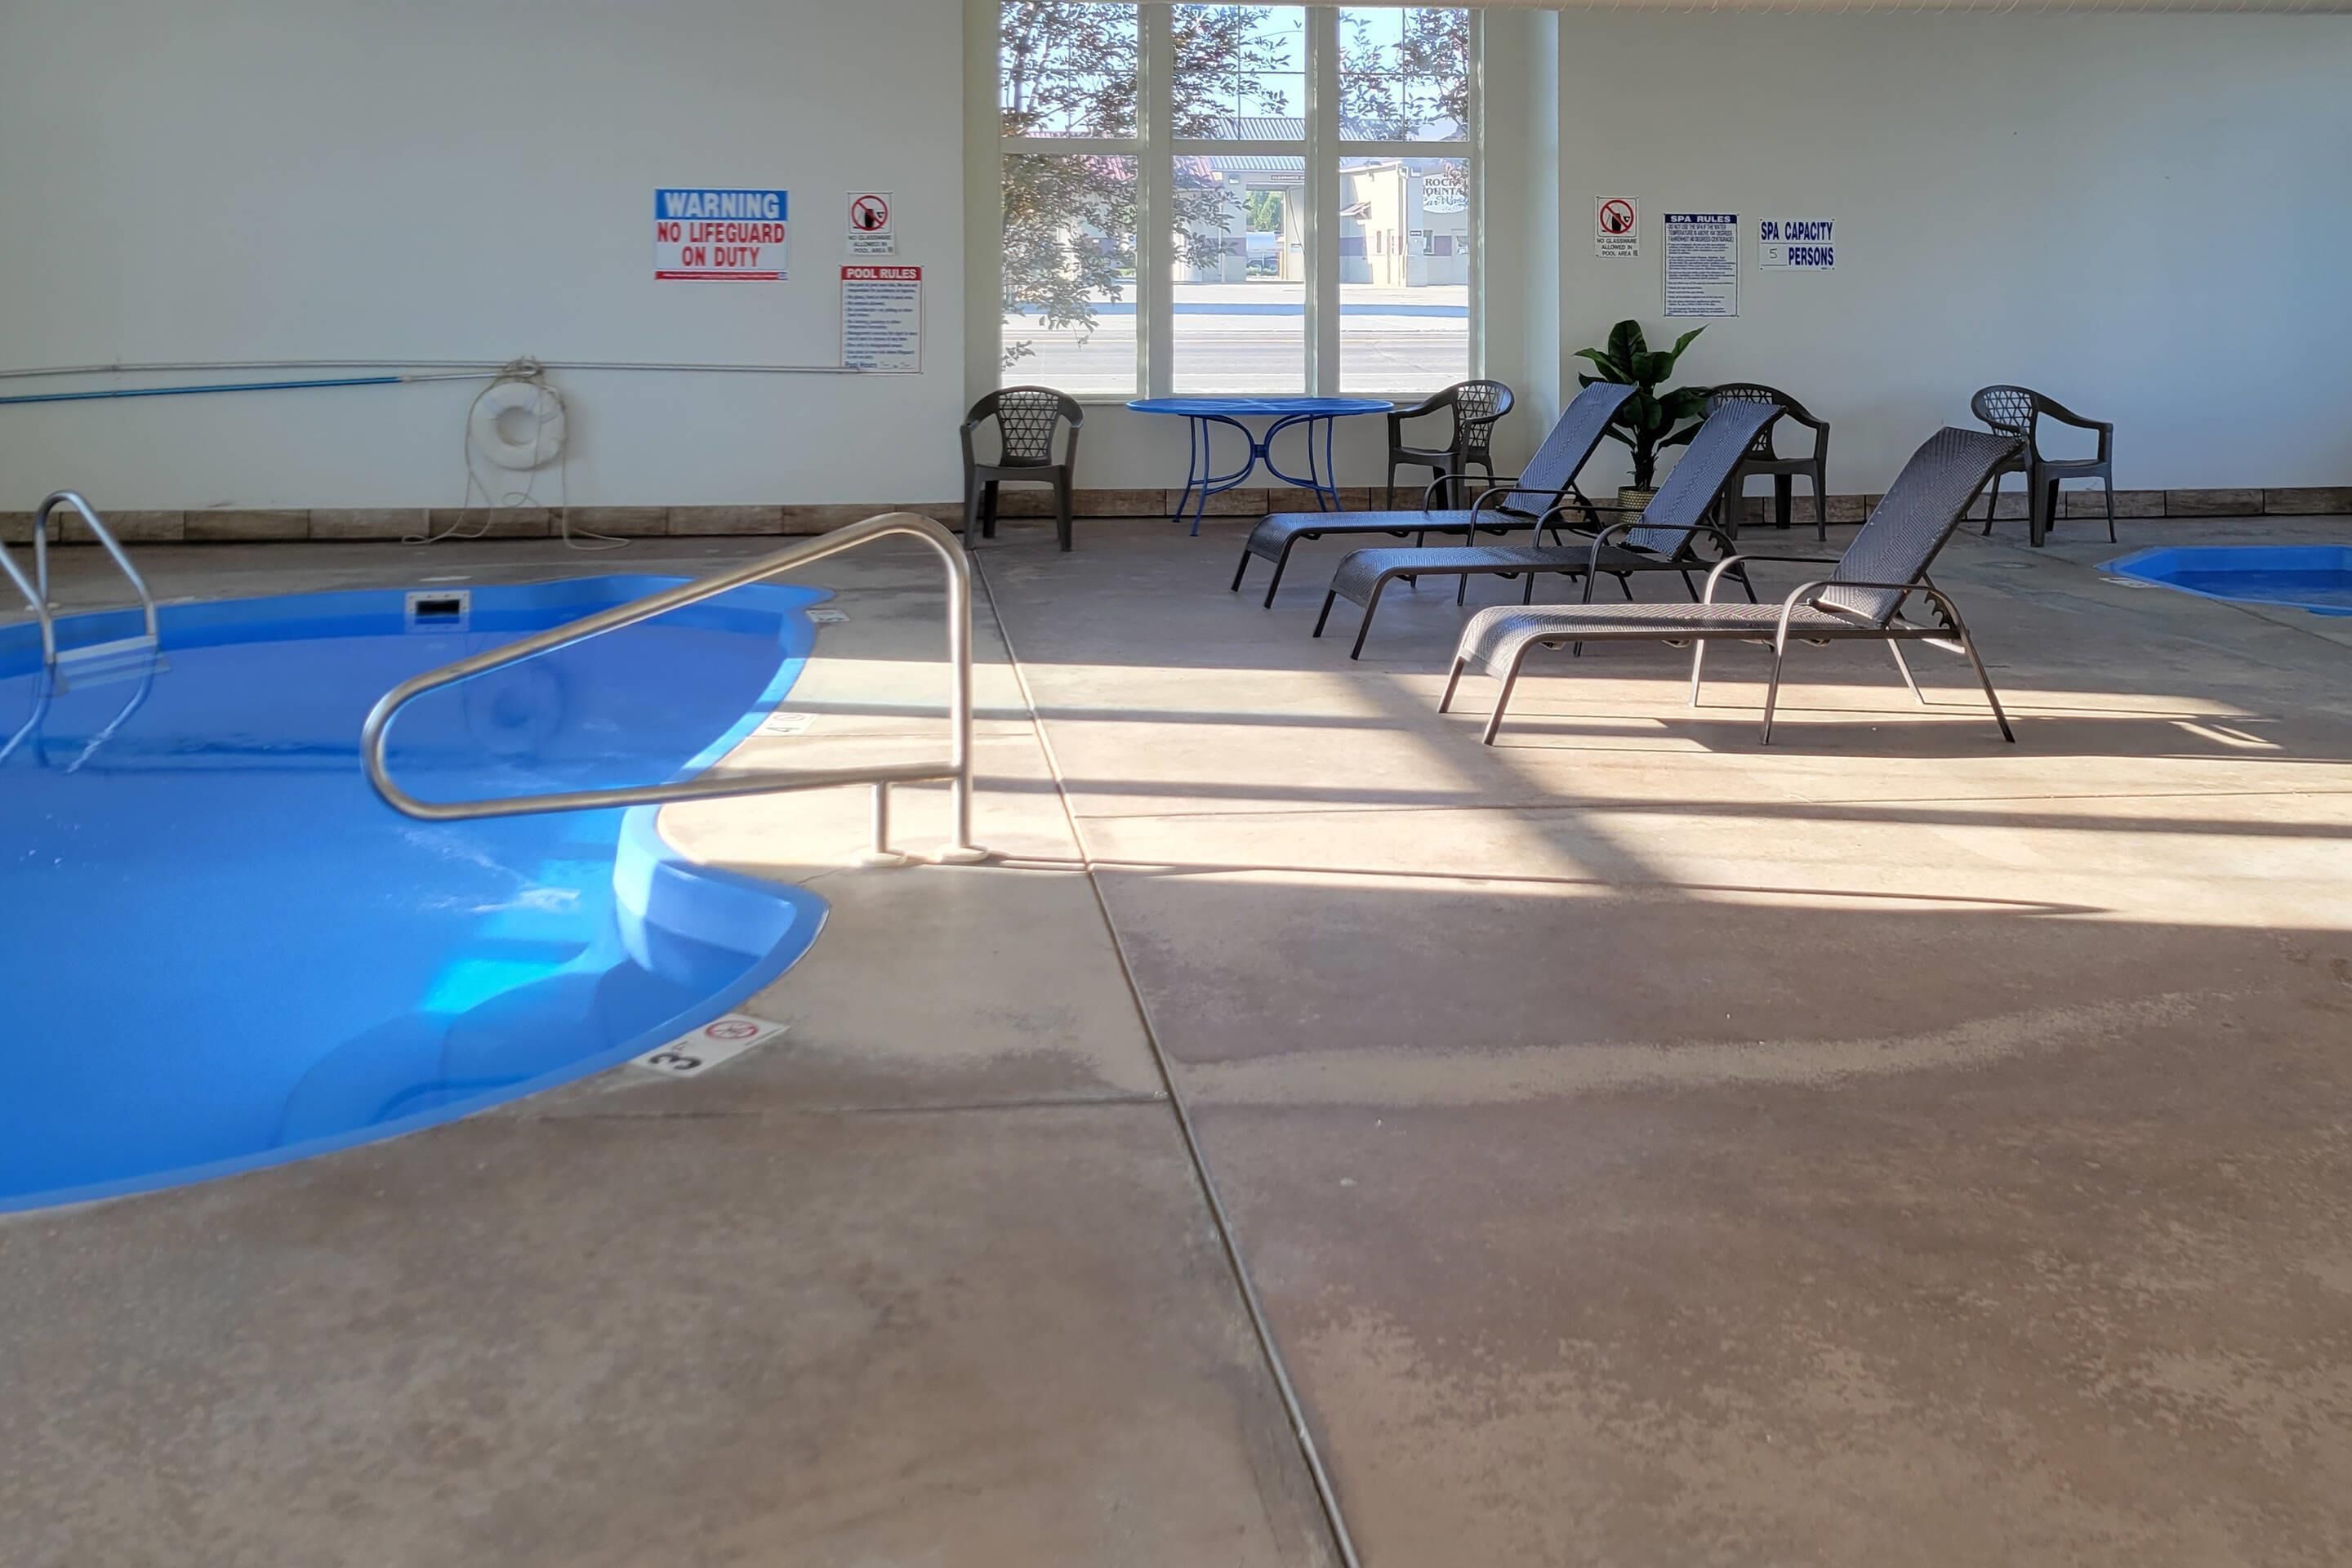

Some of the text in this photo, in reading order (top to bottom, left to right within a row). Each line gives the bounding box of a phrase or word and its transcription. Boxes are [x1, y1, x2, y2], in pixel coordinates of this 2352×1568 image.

[664, 193, 780, 219] WARNING
[1670, 215, 1692, 223] SPA
[657, 221, 785, 243] NO LIFEGUARD
[1761, 221, 1833, 240] SPA CAPACITY
[682, 246, 760, 267] ON DUTY
[1788, 247, 1833, 265] PERSONS
[846, 268, 917, 278] POOL RULES
[650, 1052, 702, 1070] 3
